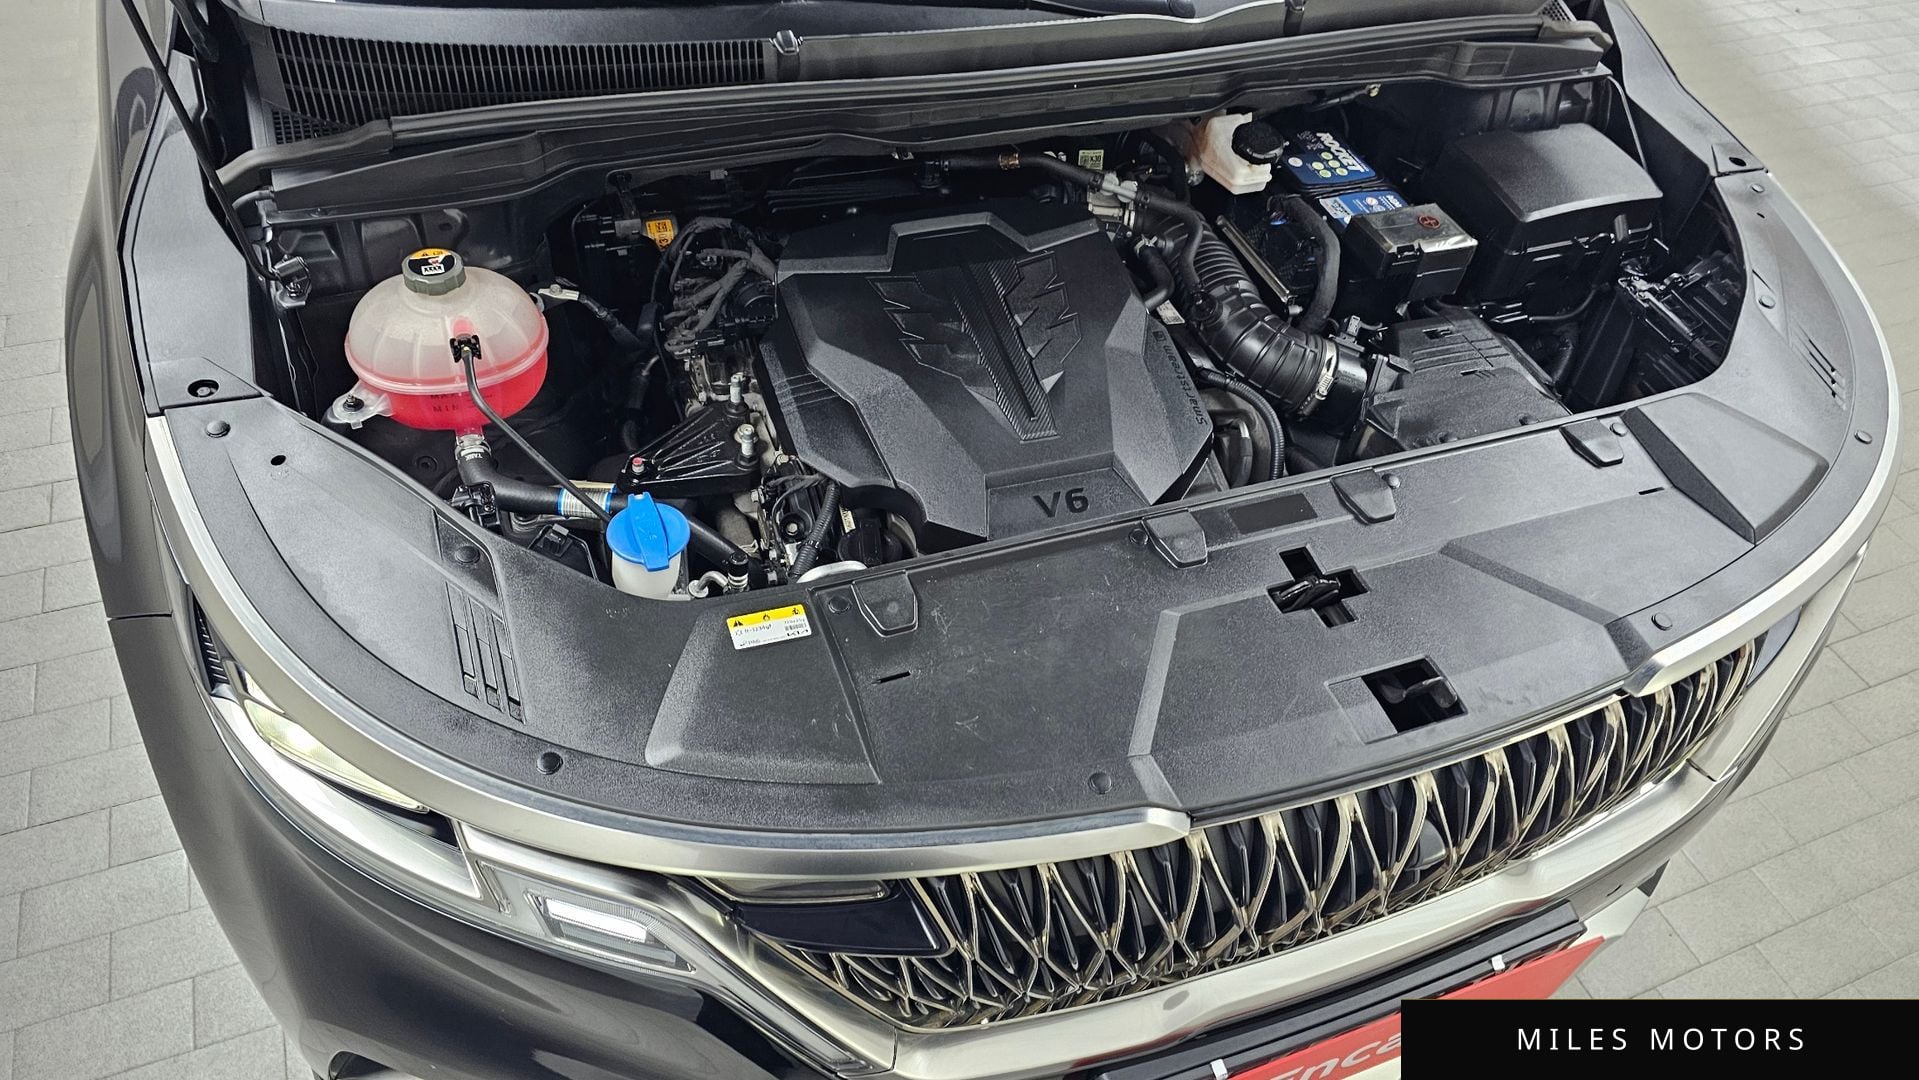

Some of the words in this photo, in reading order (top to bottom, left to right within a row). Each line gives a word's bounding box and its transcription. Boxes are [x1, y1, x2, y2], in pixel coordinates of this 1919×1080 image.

[1316, 132, 1365, 172] ROCKET
[1163, 345, 1208, 425] Smartstream
[1032, 487, 1089, 518] V6
